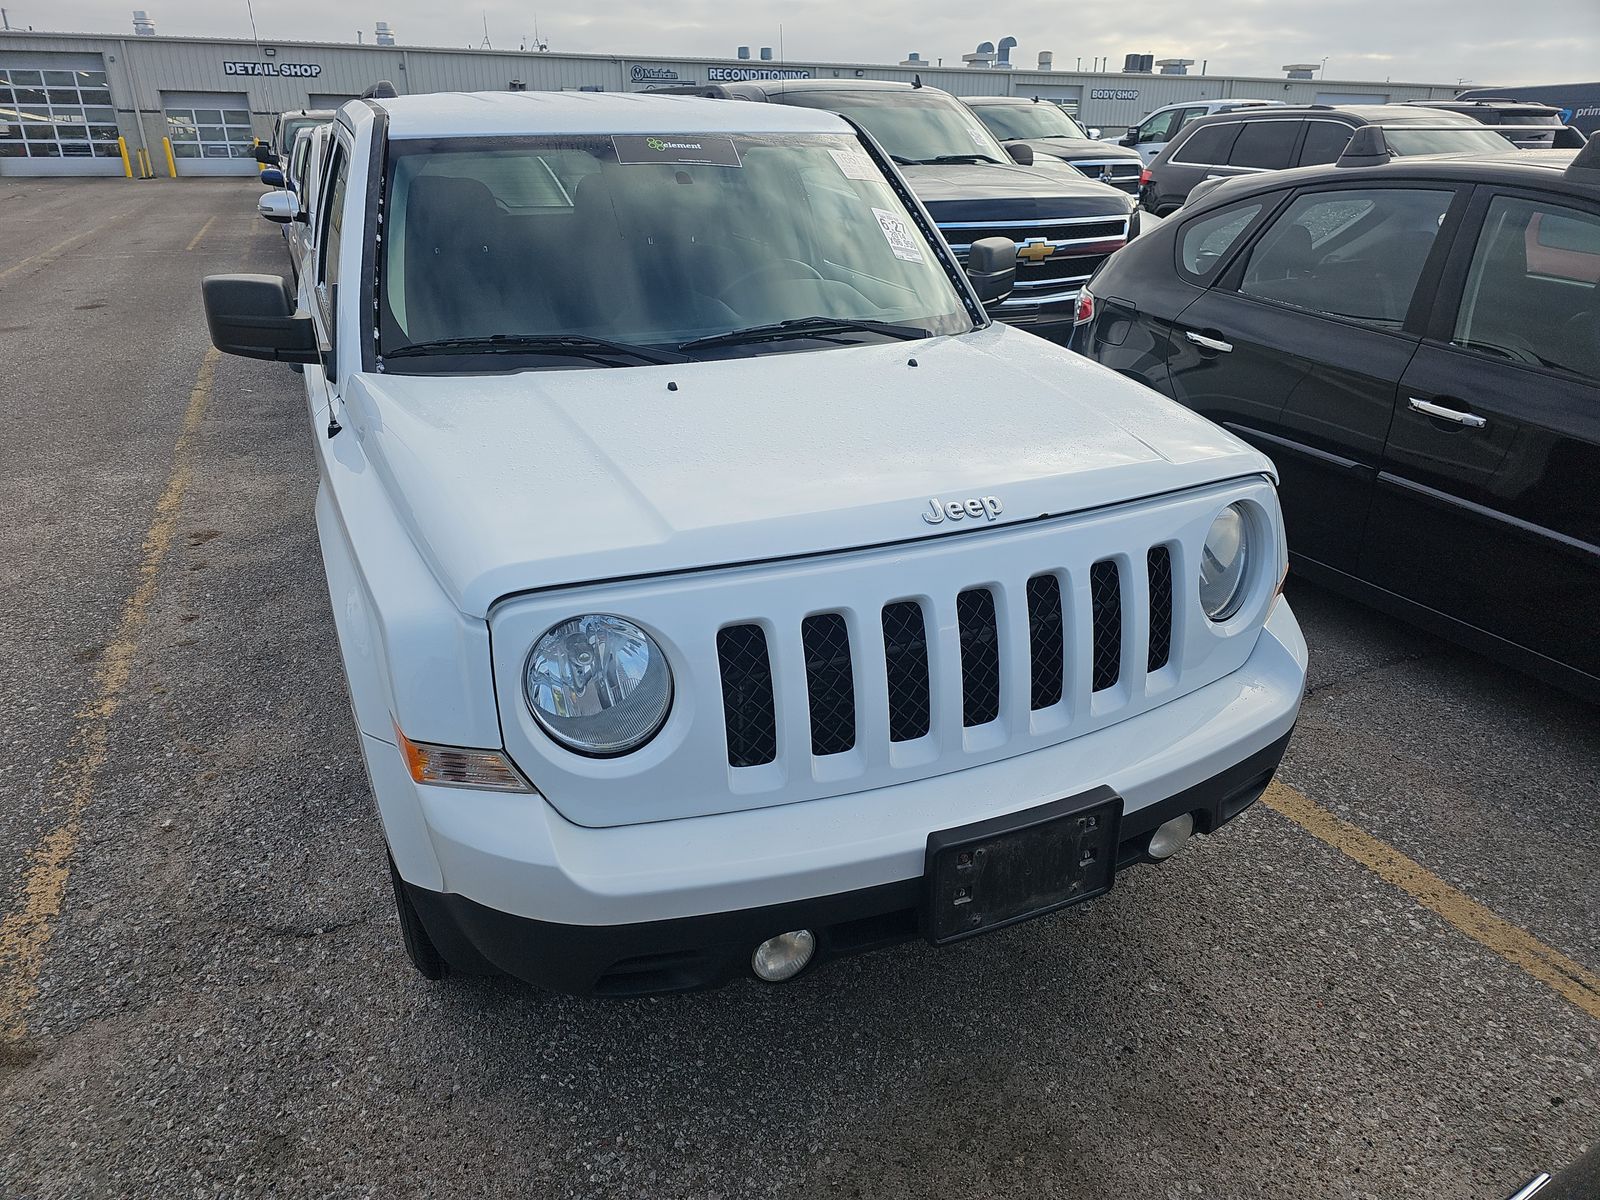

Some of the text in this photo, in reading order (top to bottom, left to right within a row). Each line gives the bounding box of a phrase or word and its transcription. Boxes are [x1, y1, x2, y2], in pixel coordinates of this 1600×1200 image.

[224, 62, 321, 77] DETAIL SHOP
[709, 68, 809, 80] RECONDITIONING
[1091, 90, 1139, 100] BODY SHOP
[922, 496, 1004, 525] Jeep
